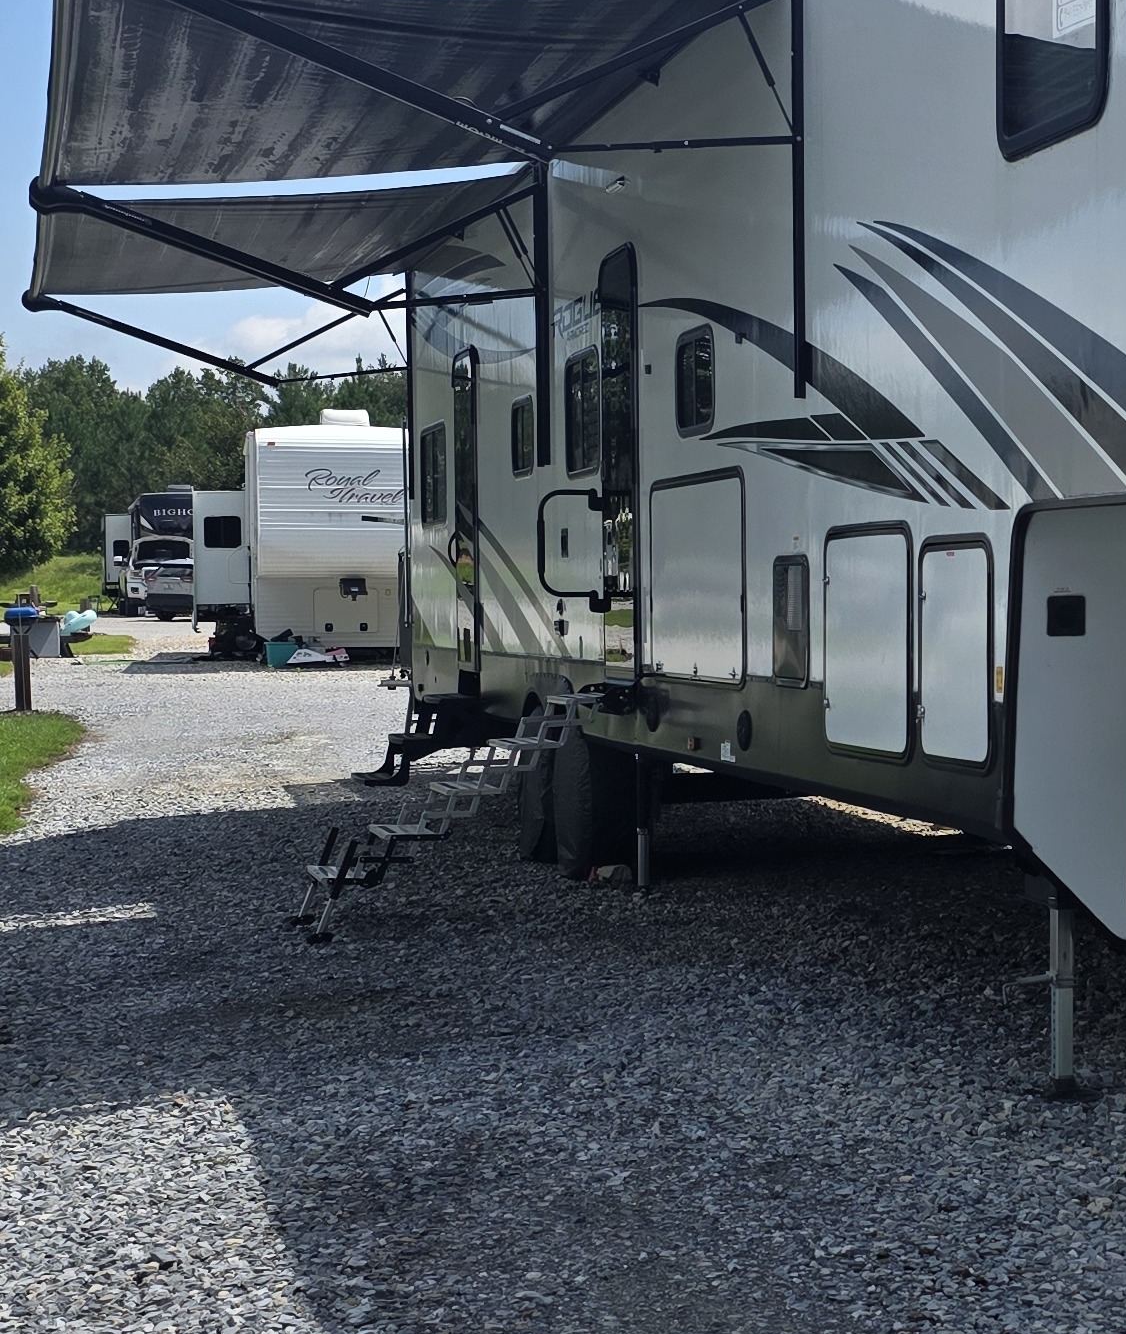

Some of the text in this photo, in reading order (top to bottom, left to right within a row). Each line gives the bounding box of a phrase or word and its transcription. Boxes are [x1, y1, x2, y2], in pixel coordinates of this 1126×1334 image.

[551, 288, 602, 339] ROGUE
[305, 468, 381, 491] Royal
[323, 487, 405, 505] Travel
